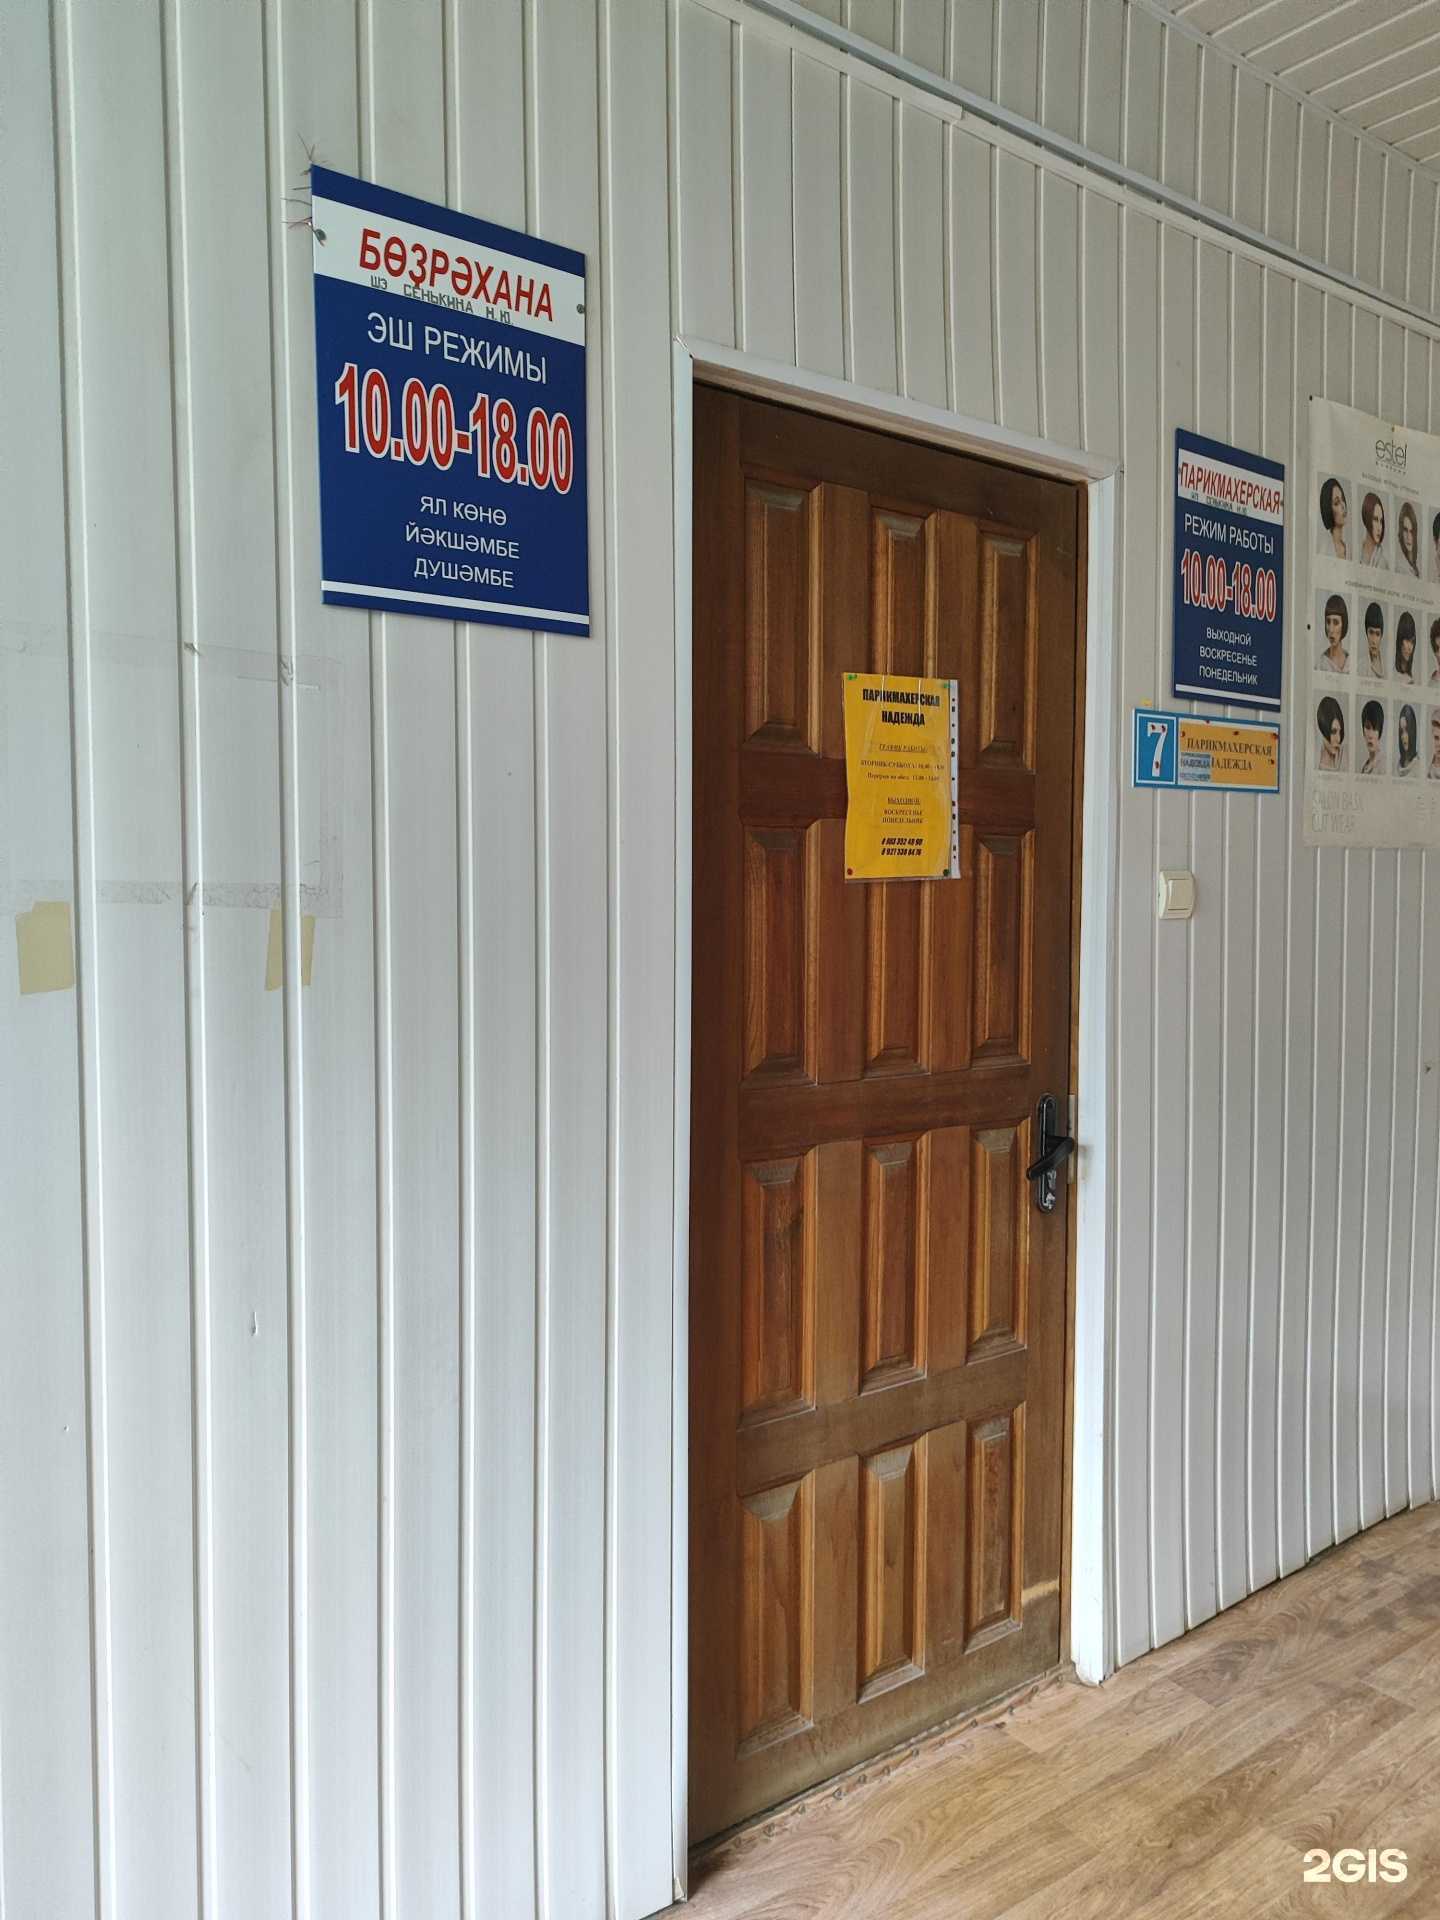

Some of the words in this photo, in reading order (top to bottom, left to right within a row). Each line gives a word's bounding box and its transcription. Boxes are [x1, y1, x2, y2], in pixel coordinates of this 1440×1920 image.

[360, 228, 553, 322] БӨҘРӘХАНА
[403, 283, 474, 314] СЕНЬКИНА
[367, 311, 413, 352] ЭШ
[425, 325, 547, 385] РЕЖИМЫ
[334, 361, 574, 495] 10.00-18.00
[1375, 439, 1408, 468] estel
[1180, 461, 1281, 515] ПАРИКМАХЕРСКАЯ
[420, 495, 448, 517] ЯЛ
[453, 501, 507, 527] КӨНӨ
[406, 523, 520, 560] ЙӘКШӘМБЕ
[1184, 513, 1226, 543] РЕЖИМ
[1229, 526, 1274, 555] РАБОТЫ
[413, 558, 515, 589] ДУШӘМБЕ
[1180, 548, 1277, 622] 10.00-18.00
[1206, 627, 1252, 647] ВЫХОДНОЙ
[1199, 646, 1258, 667] ВОСКРЕСЕНЬЕ
[1199, 665, 1258, 686] ПОНЕДЕЛЬНИК
[862, 688, 941, 707] ПАРИКМАХЕРСКАЯ
[881, 710, 925, 727] НАДЕЖДА
[1147, 721, 1168, 777] 7
[1187, 737, 1273, 757] ПАРИКМАХЕРСКАЯ
